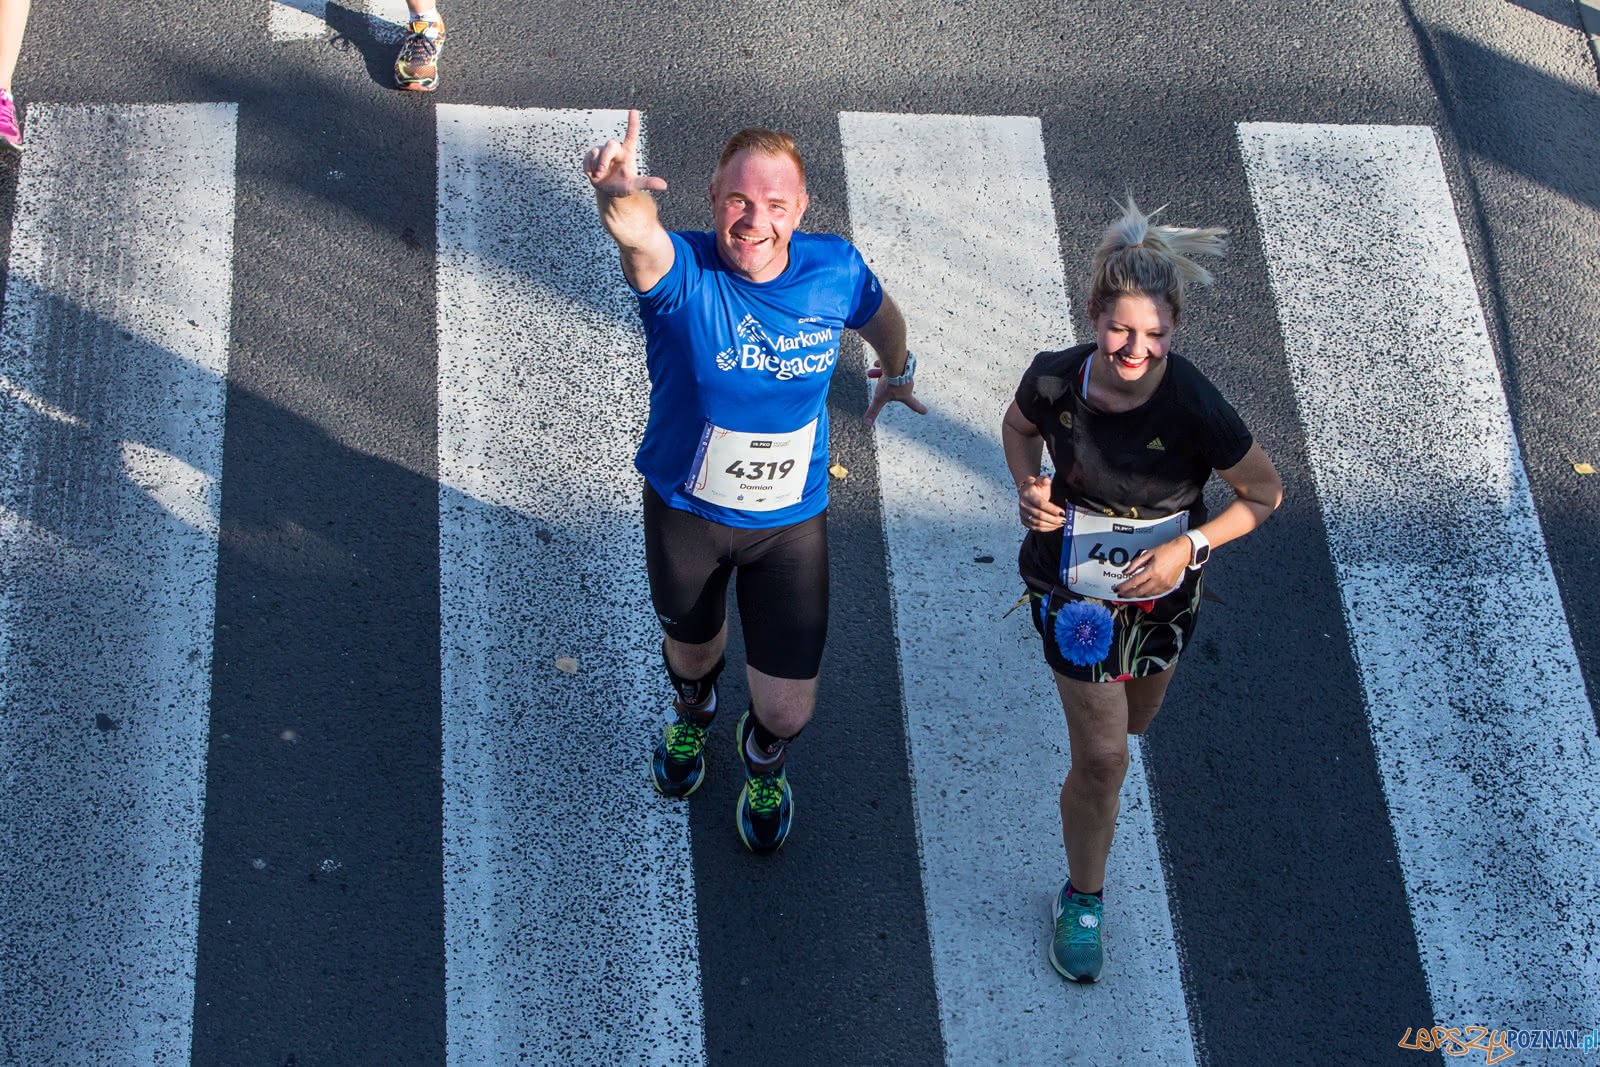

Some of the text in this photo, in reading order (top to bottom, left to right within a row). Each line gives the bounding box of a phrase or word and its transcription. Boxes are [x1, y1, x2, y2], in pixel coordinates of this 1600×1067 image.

[770, 326, 833, 353] Markowi
[741, 344, 835, 381] Biegacze
[725, 459, 795, 480] 4319
[739, 483, 773, 491] Damian
[1088, 543, 1147, 568] 40
